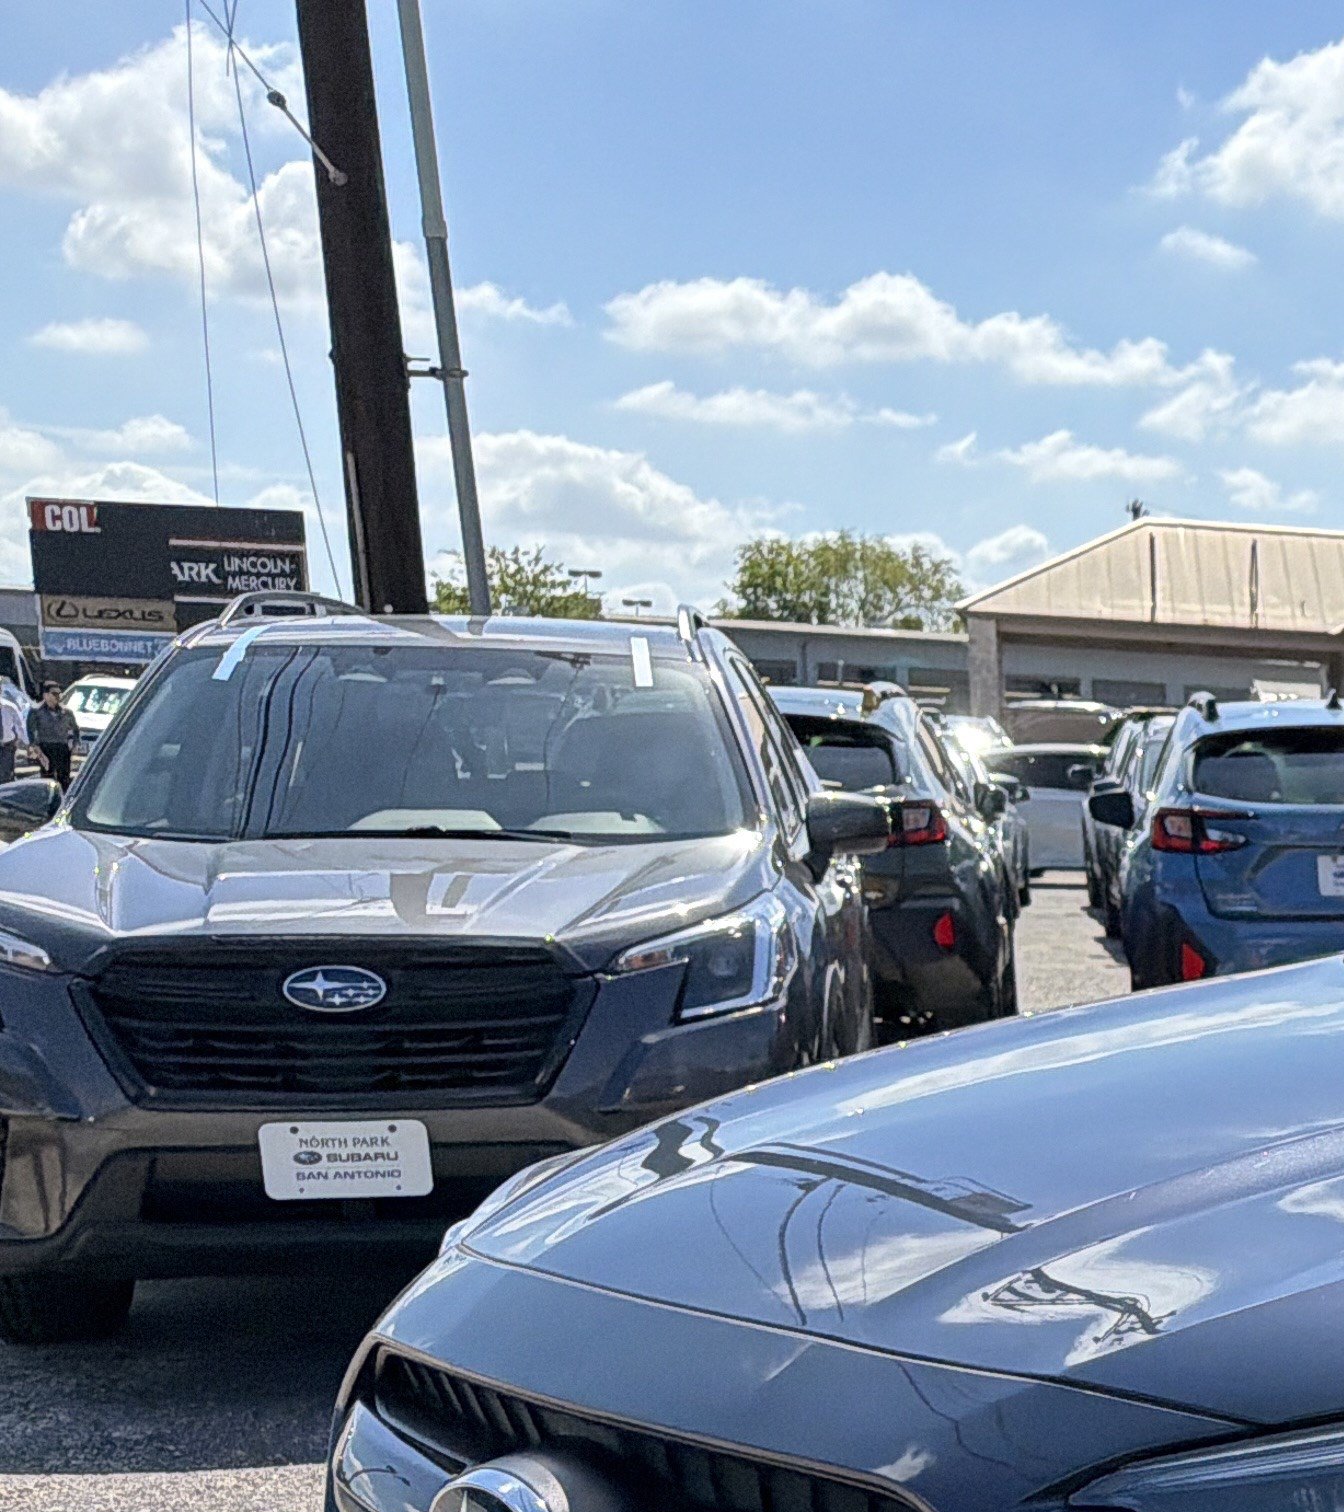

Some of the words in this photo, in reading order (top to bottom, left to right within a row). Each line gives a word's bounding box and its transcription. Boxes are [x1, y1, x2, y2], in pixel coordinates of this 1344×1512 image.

[227, 575, 298, 592] MERCURY
[82, 607, 164, 621] LEXUS
[299, 1135, 348, 1149] NORTH
[352, 1136, 391, 1148] PARK
[326, 1151, 399, 1163] SUBARU
[296, 1171, 329, 1181] SAN
[333, 1169, 402, 1180] ANTONIO
